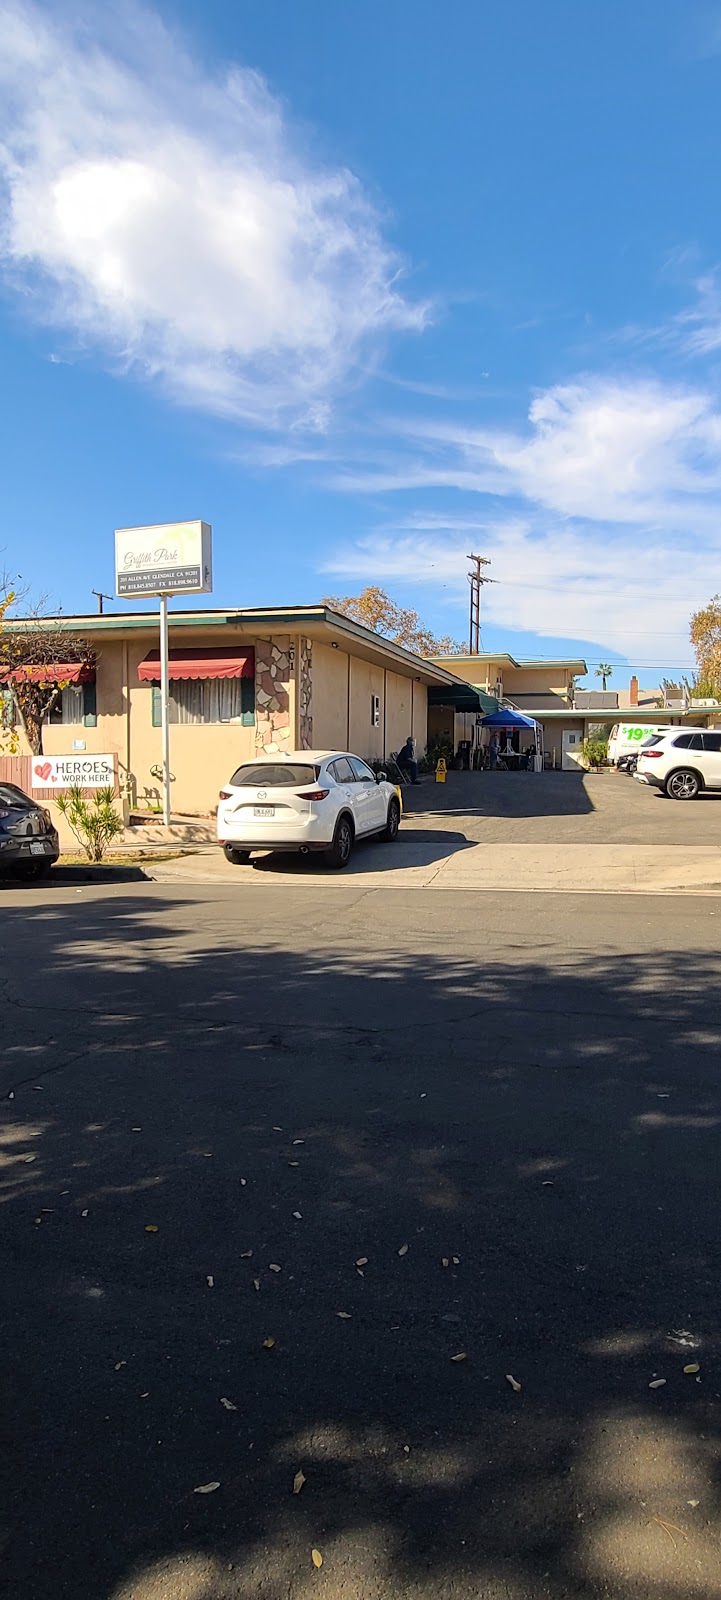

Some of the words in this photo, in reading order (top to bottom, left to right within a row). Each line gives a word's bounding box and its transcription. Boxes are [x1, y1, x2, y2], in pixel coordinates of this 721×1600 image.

[123, 552, 152, 570] Griffith
[154, 548, 178, 562] Park
[56, 761, 109, 774] HEROES
[62, 774, 87, 782] WORK
[88, 774, 110, 782] HERE
